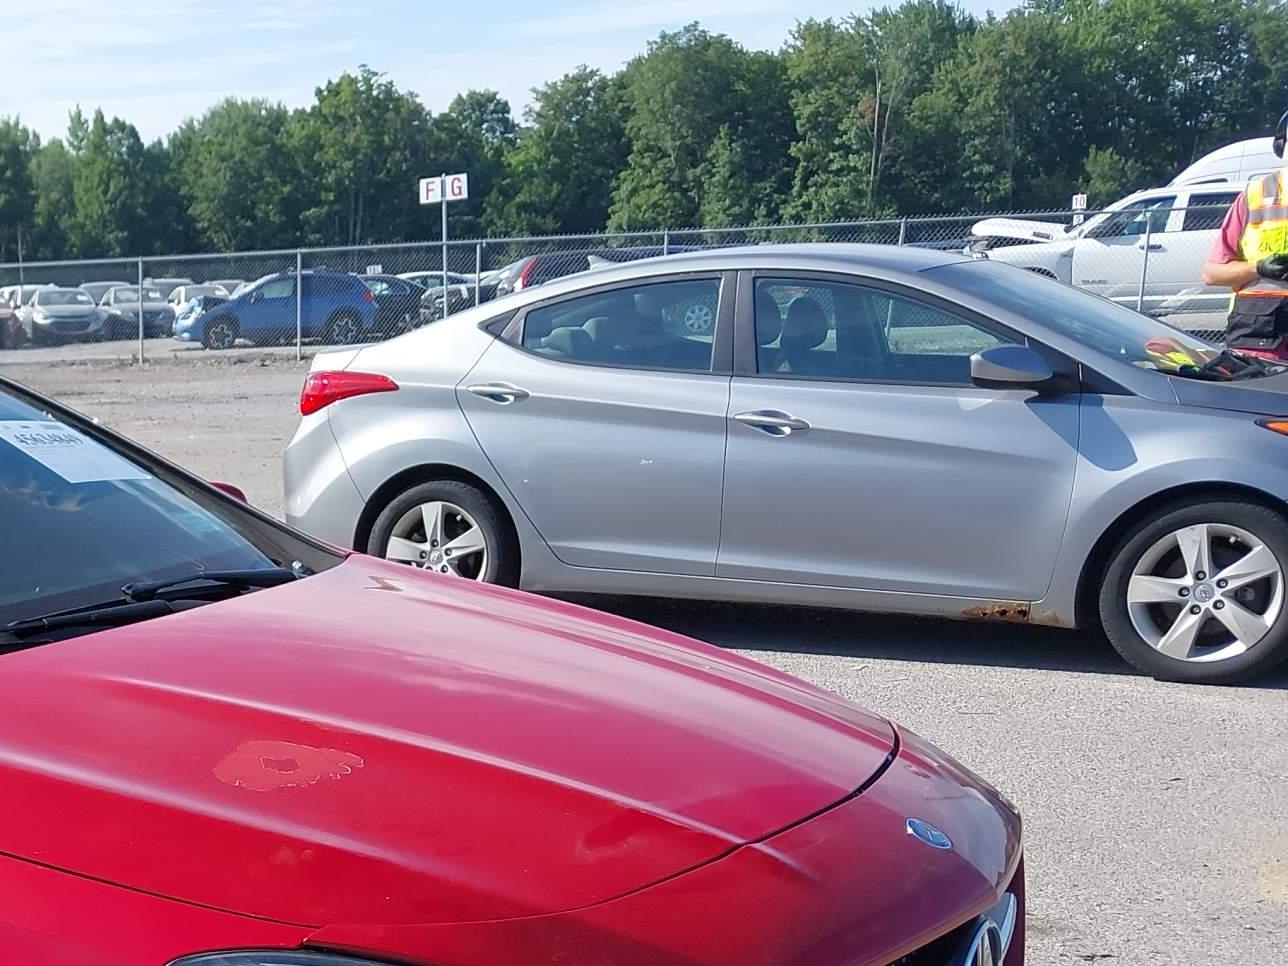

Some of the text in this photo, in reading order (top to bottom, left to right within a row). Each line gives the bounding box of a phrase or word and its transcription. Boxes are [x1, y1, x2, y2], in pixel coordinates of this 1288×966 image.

[425, 177, 462, 200] F G
[1075, 196, 1085, 207] 10
